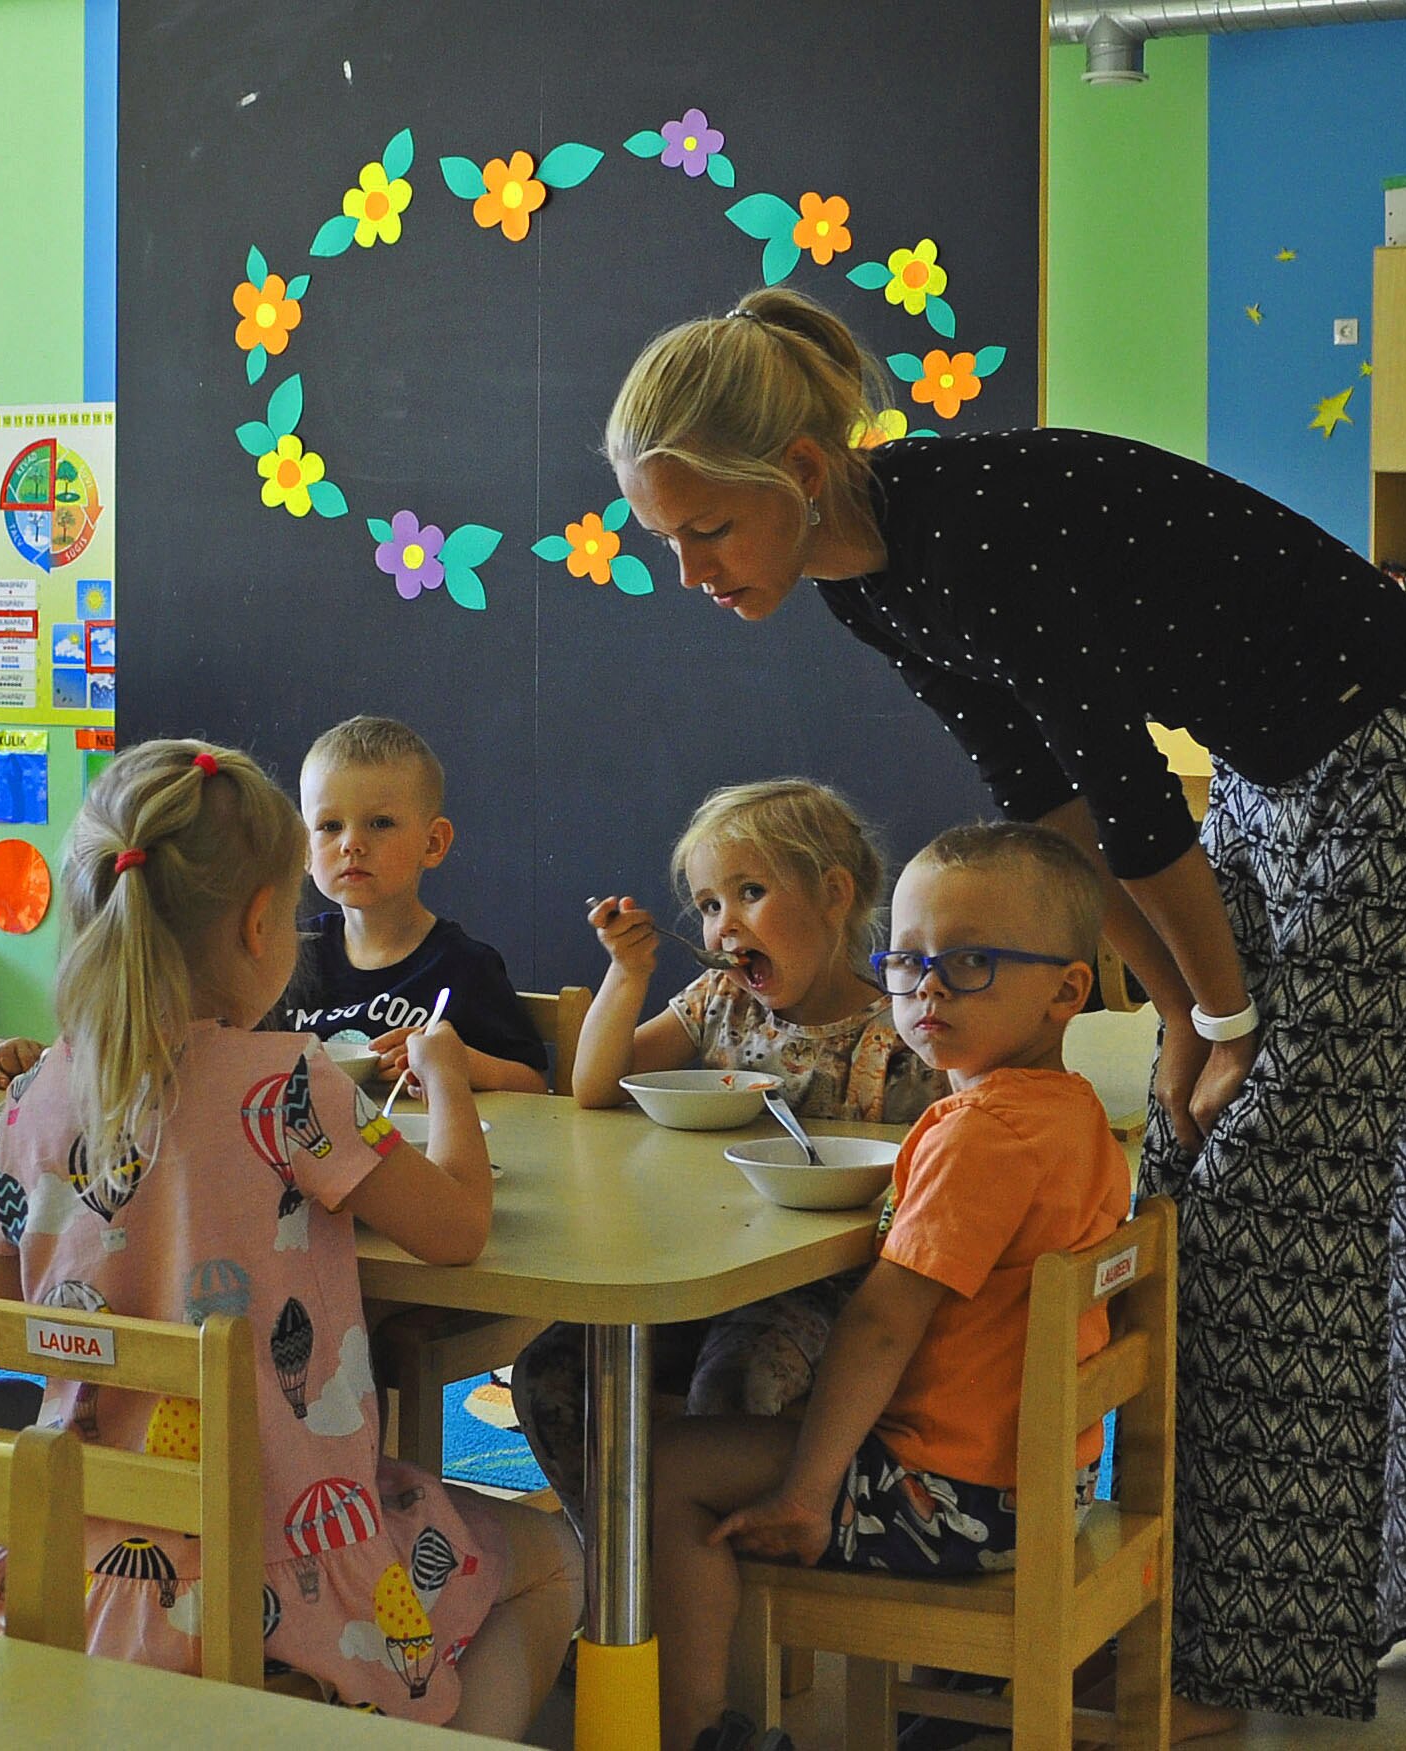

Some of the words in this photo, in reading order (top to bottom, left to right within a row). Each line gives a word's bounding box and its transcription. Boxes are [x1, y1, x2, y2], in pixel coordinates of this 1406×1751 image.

[15, 451, 38, 476] KEVAD
[8, 523, 24, 547] TALV
[39, 1330, 102, 1357] LAURA
